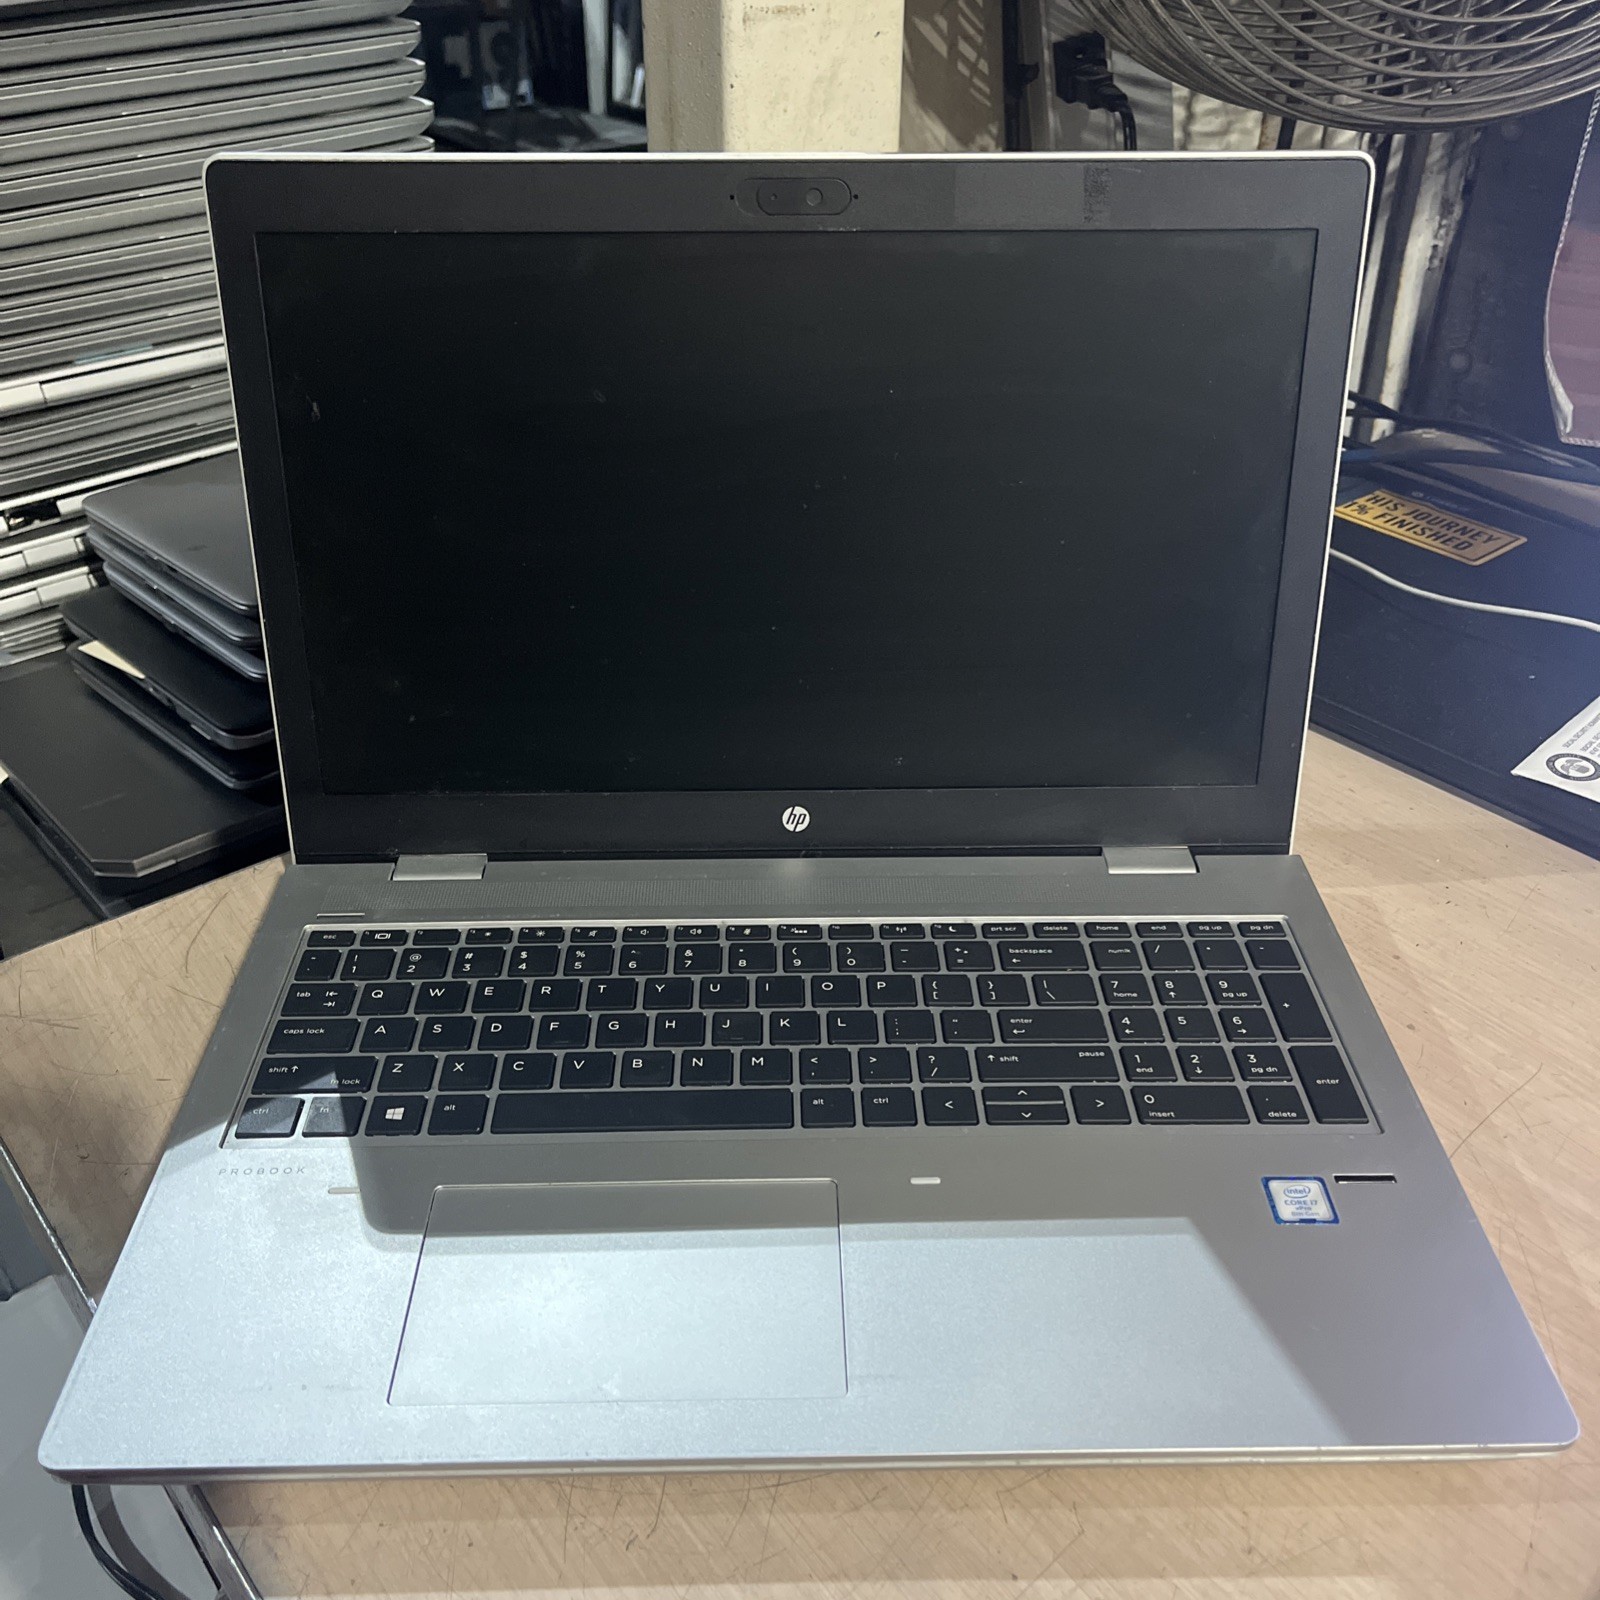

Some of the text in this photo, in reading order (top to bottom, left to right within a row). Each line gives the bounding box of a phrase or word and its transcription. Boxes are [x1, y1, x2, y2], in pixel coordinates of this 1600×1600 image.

[1408, 508, 1501, 544] JOURNEY
[1373, 512, 1474, 550] FINISHED
[783, 806, 809, 832] hp
[485, 987, 493, 995] E
[598, 985, 606, 993] T
[372, 990, 383, 998] Q
[609, 1021, 619, 1029] G
[723, 1020, 729, 1028] J
[838, 1018, 846, 1026] L
[433, 1025, 442, 1033] S
[491, 1024, 501, 1032] D
[633, 1059, 642, 1067] B
[693, 1058, 703, 1066] N
[752, 1057, 763, 1065] M
[1191, 1055, 1199, 1063] 2
[392, 1064, 403, 1072] Z
[453, 1063, 464, 1071] X
[514, 1062, 524, 1070] C
[574, 1061, 584, 1069] V
[218, 1166, 306, 1176] PROBOOK
